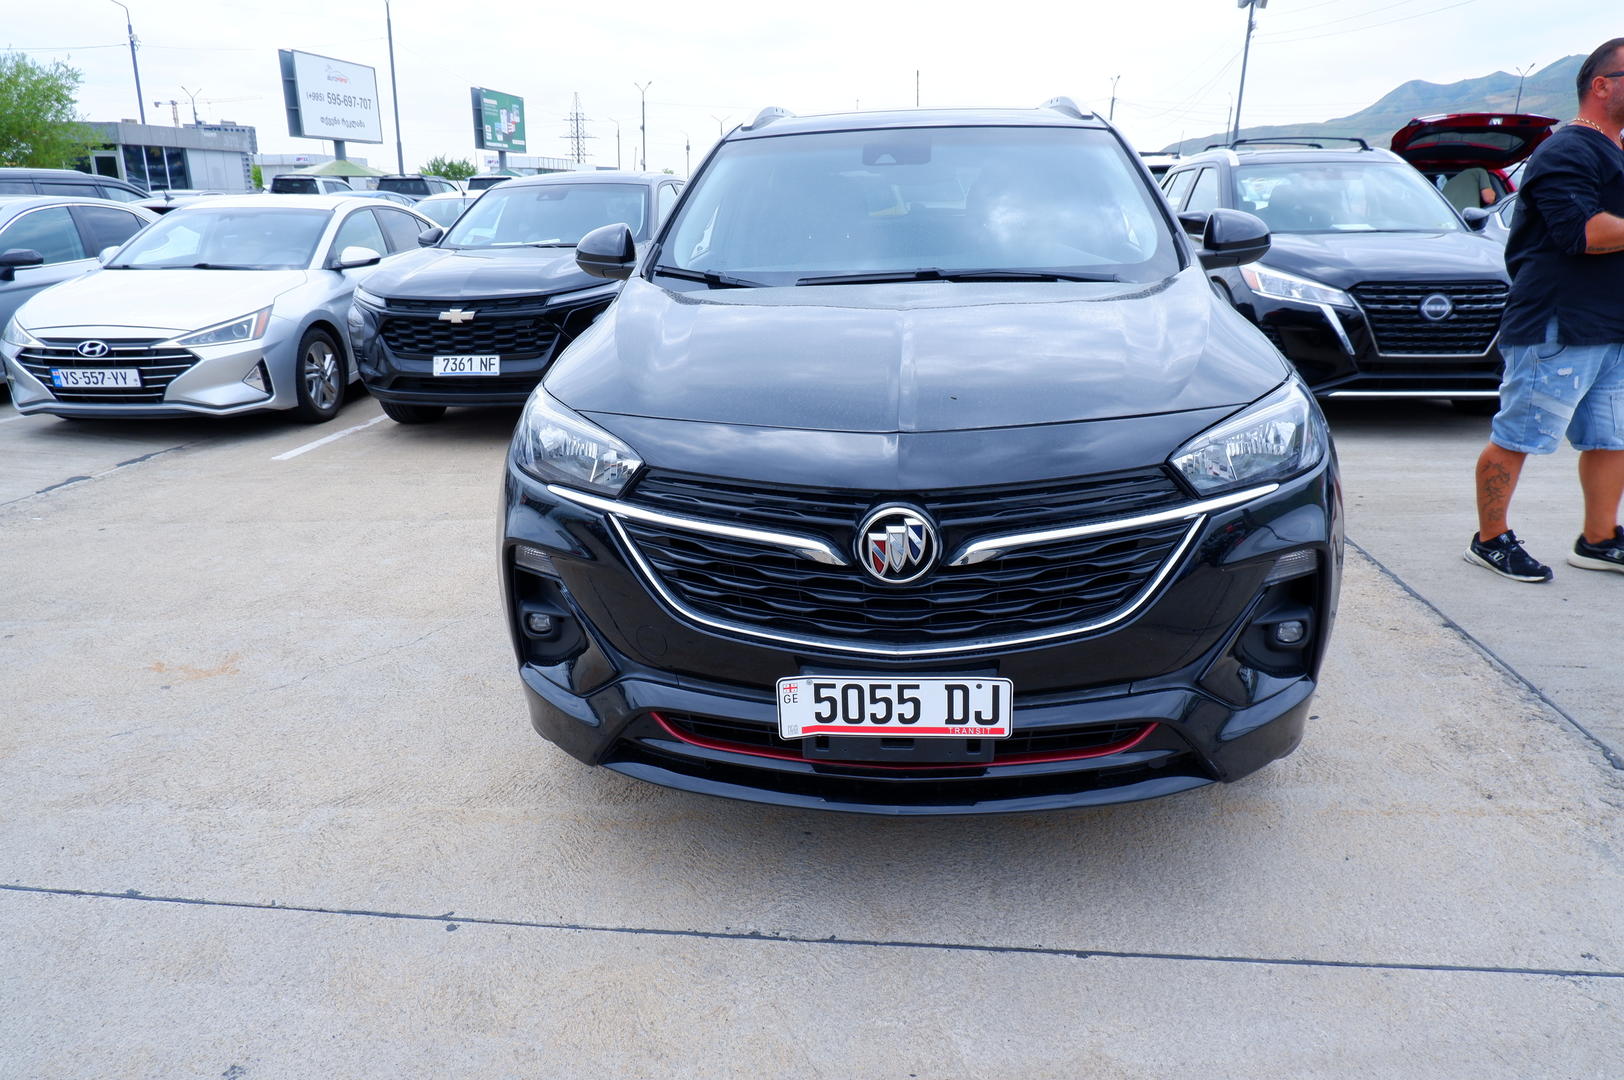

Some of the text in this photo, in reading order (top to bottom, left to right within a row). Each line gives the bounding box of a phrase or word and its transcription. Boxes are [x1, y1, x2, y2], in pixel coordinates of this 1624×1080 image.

[327, 91, 372, 110] 595-697-707
[443, 357, 497, 372] 7361 NF
[61, 371, 127, 385] YS-557-YY
[783, 693, 799, 704] GE
[813, 683, 1001, 726] 5055 DJ
[948, 727, 992, 735] TRANSIT
